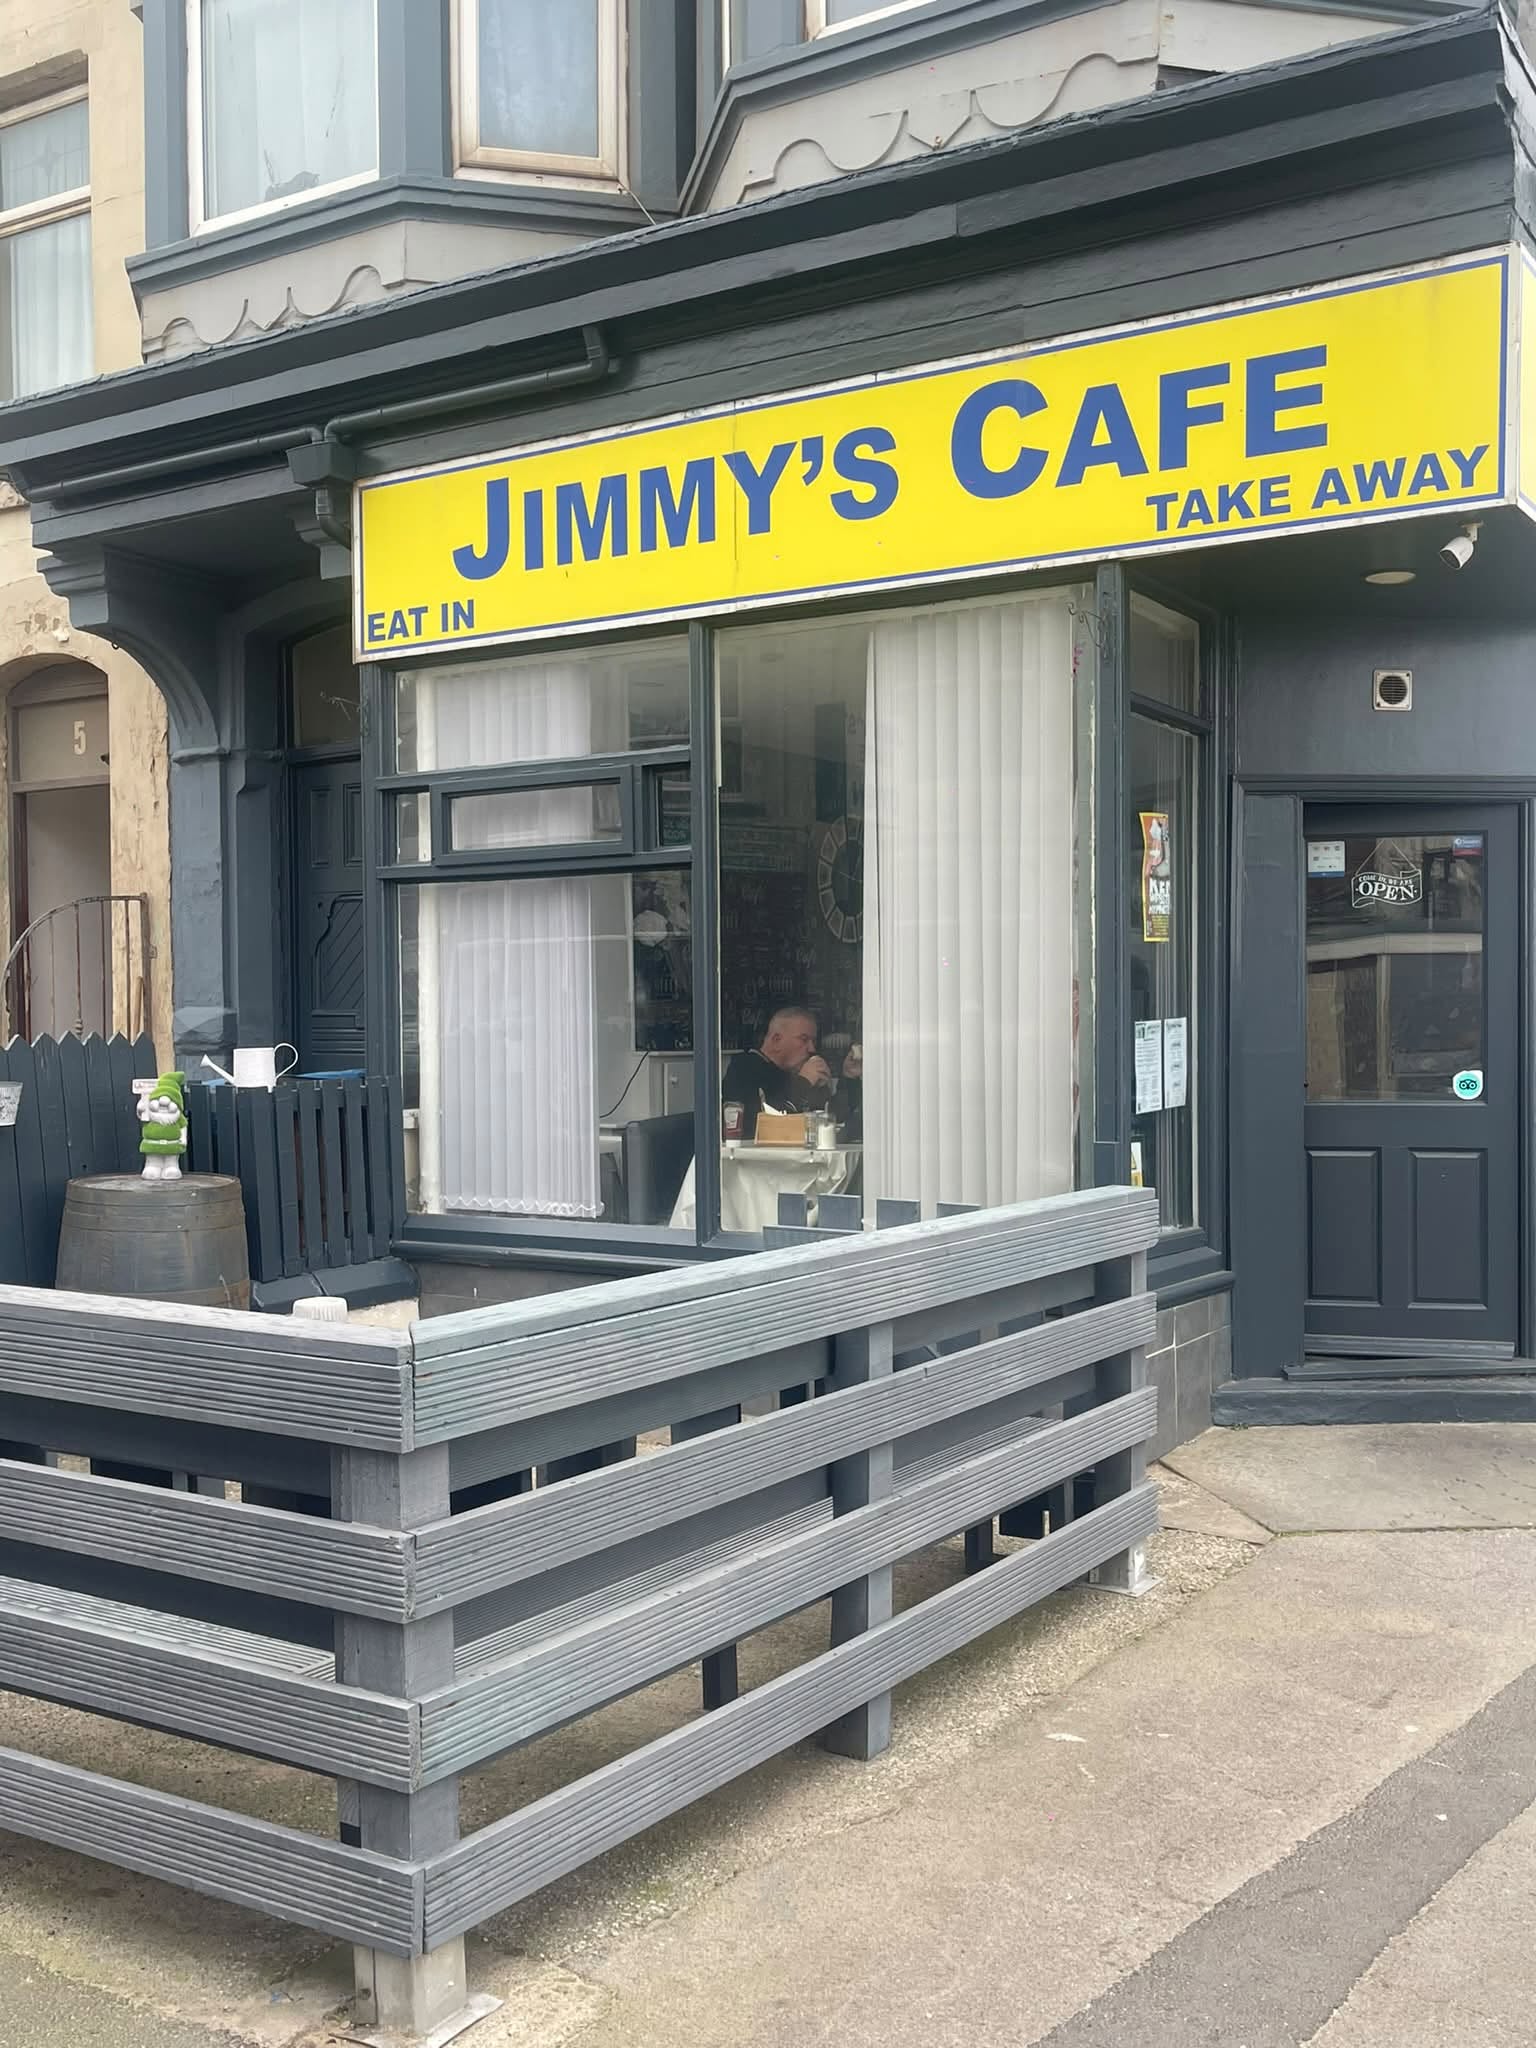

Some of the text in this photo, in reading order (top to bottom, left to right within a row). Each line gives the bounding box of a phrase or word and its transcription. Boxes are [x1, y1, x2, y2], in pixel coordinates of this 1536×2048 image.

[452, 344, 1328, 580] JIMMY'S CAFE
[1146, 444, 1491, 532] TAKE AWAY
[367, 599, 475, 643] EAT IN
[74, 720, 86, 755] 5
[1359, 881, 1415, 900] OPEN
